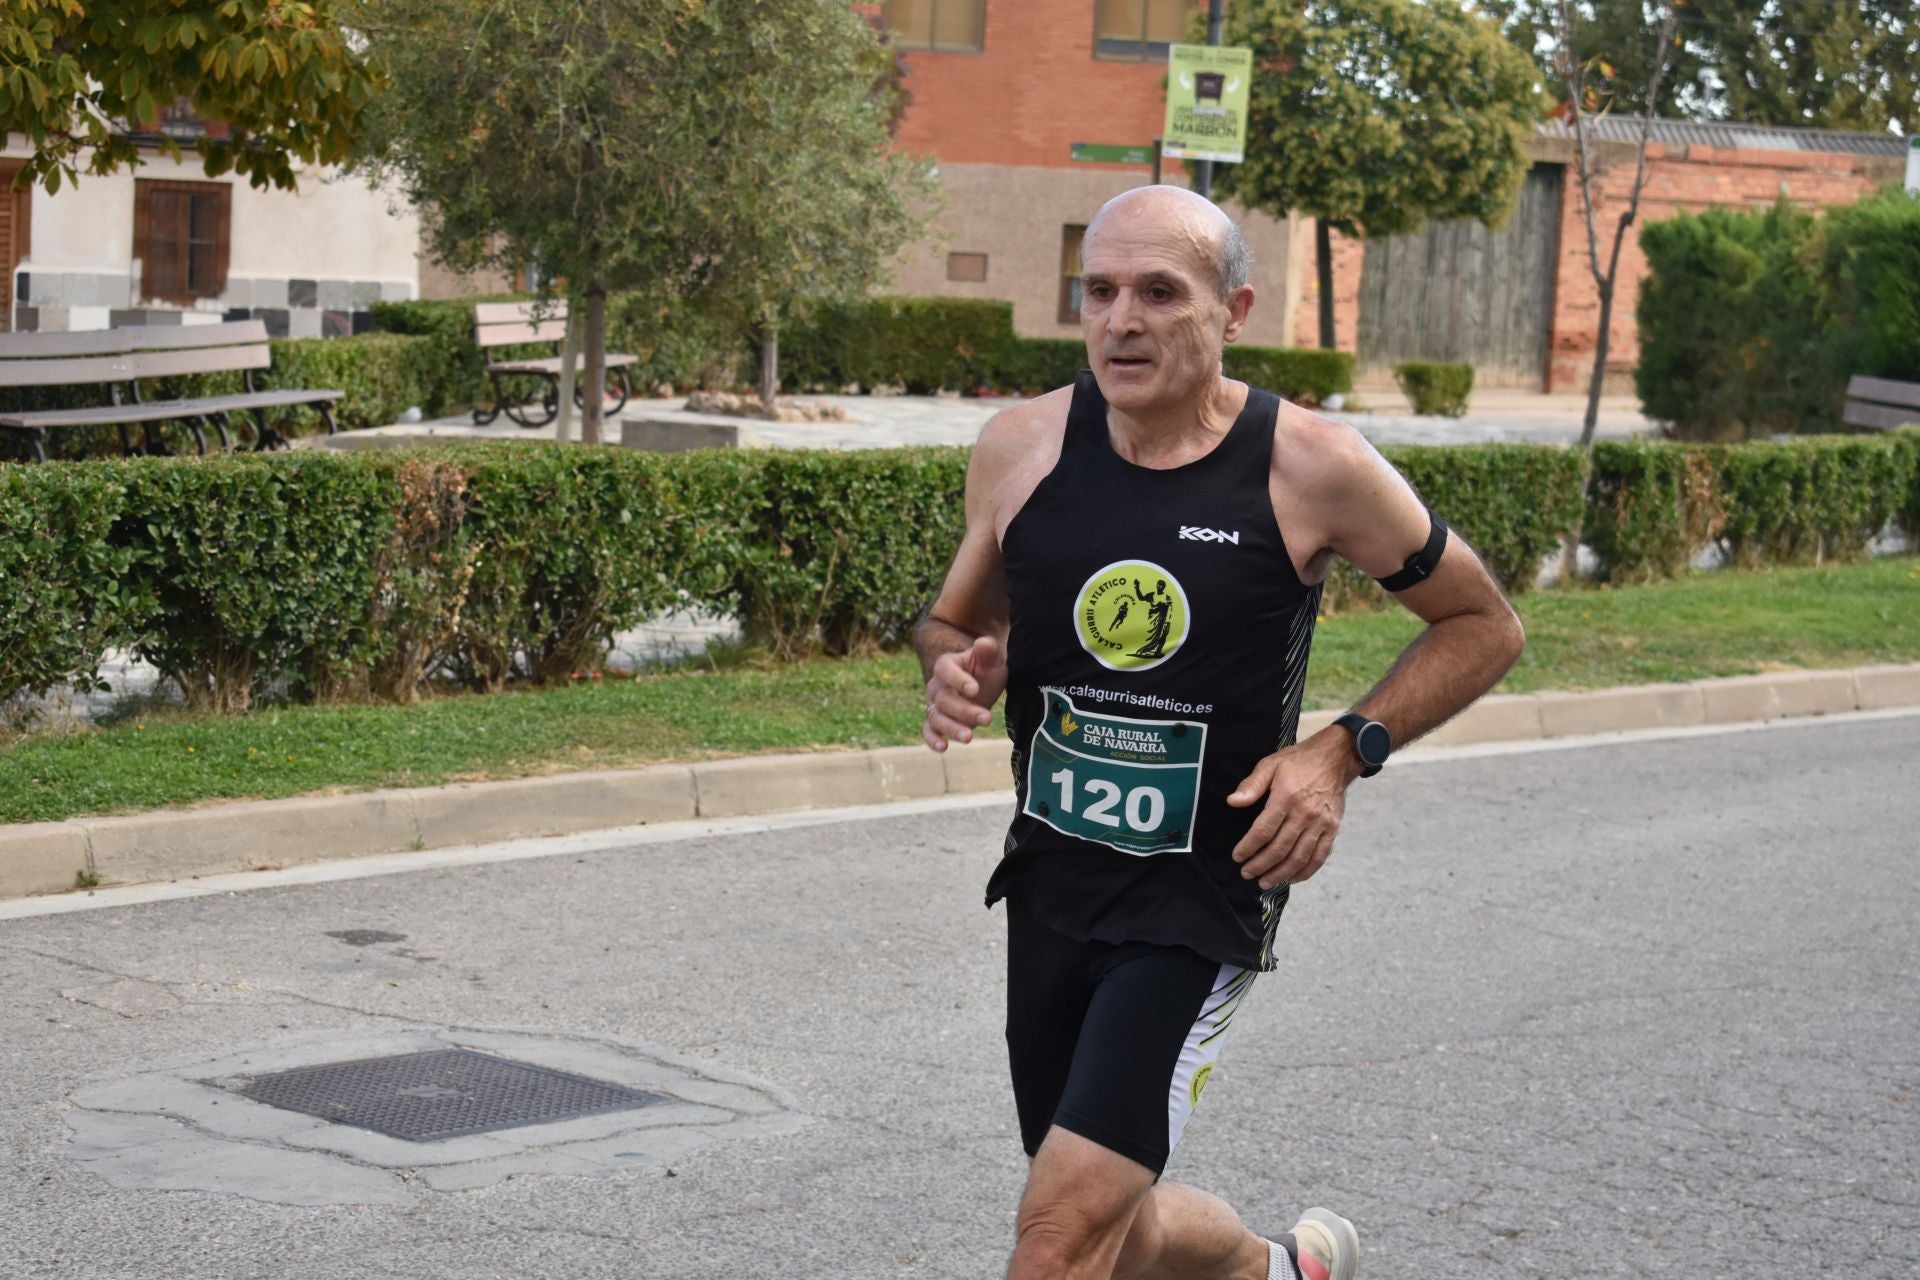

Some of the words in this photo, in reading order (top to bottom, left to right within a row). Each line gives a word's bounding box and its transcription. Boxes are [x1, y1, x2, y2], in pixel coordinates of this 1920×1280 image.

[1089, 577, 1127, 606] ATLETICO
[1086, 608, 1123, 650] CALAGURRIS
[1083, 723, 1113, 738] CAJA
[1117, 728, 1163, 743] RURAL
[1083, 733, 1101, 746] DE
[1103, 739, 1167, 753] NAVARRA
[1052, 768, 1166, 832] 120
